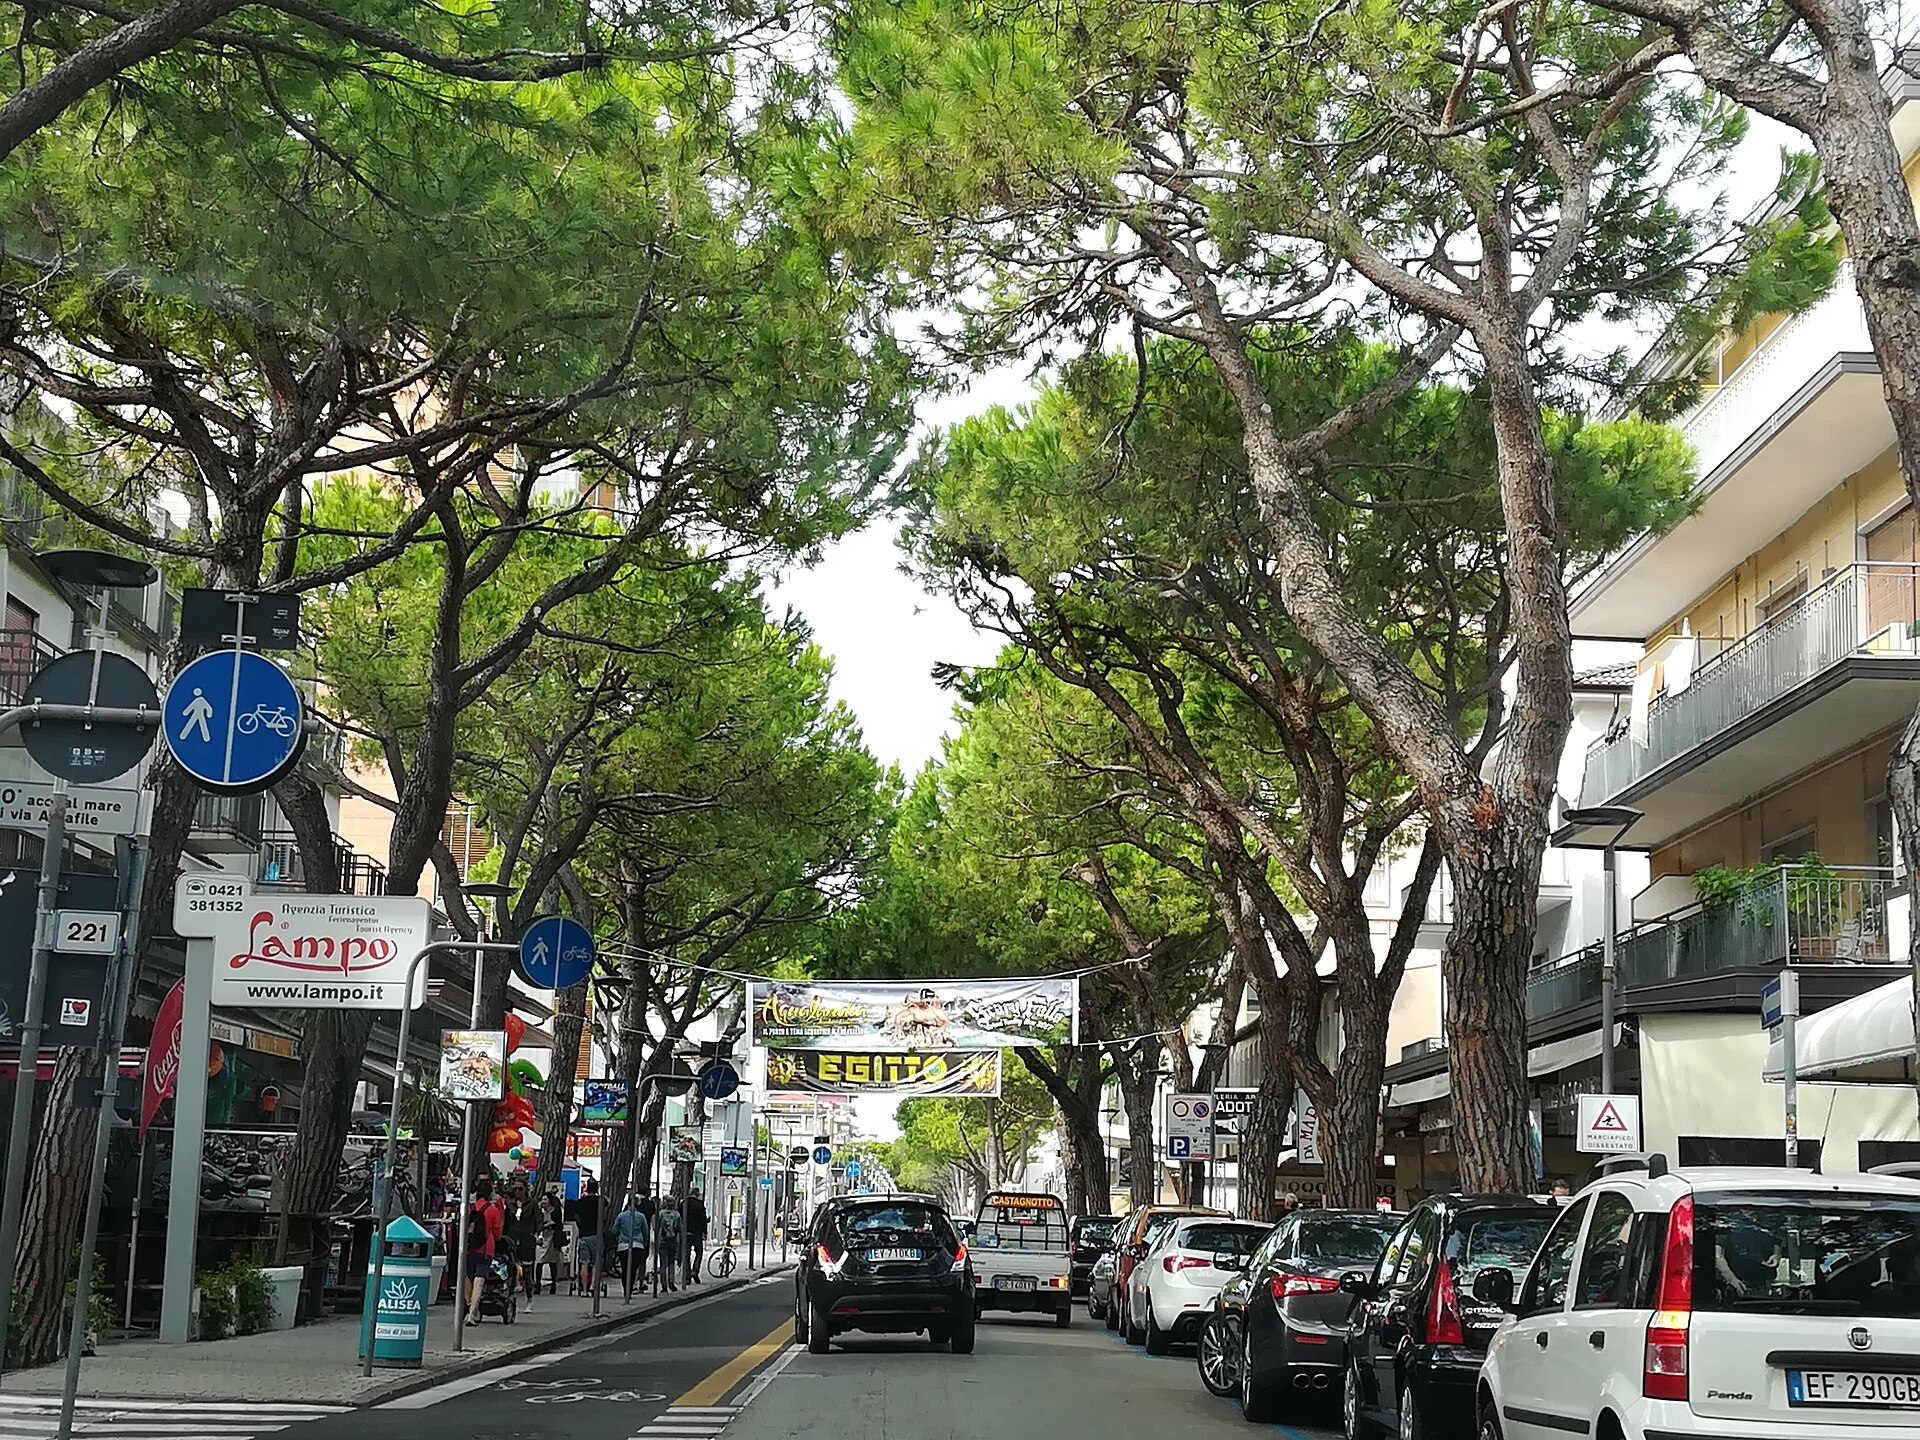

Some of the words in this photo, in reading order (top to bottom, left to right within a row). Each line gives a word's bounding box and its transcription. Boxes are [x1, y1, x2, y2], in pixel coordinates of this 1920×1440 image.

[84, 801, 122, 812] mare
[11, 808, 32, 821] via
[64, 813, 99, 825] afile
[208, 885, 243, 896] 0421
[189, 900, 243, 912] 381352
[281, 903, 326, 915] Agenzia
[329, 904, 376, 916] Turistica
[67, 922, 107, 942] 221
[356, 925, 382, 933] Tourist
[230, 911, 398, 977] Lampo
[247, 984, 384, 1004] www.lampo.it
[818, 1054, 948, 1083] EGITTO
[1215, 1100, 1254, 1113] ADOT
[992, 1195, 1054, 1207] CASTAGNOTTO
[377, 1298, 421, 1310] ALISEA
[1806, 1373, 1835, 1398] EF
[1846, 1375, 1920, 1401] 290GB
[1707, 1390, 1753, 1401] Panda
